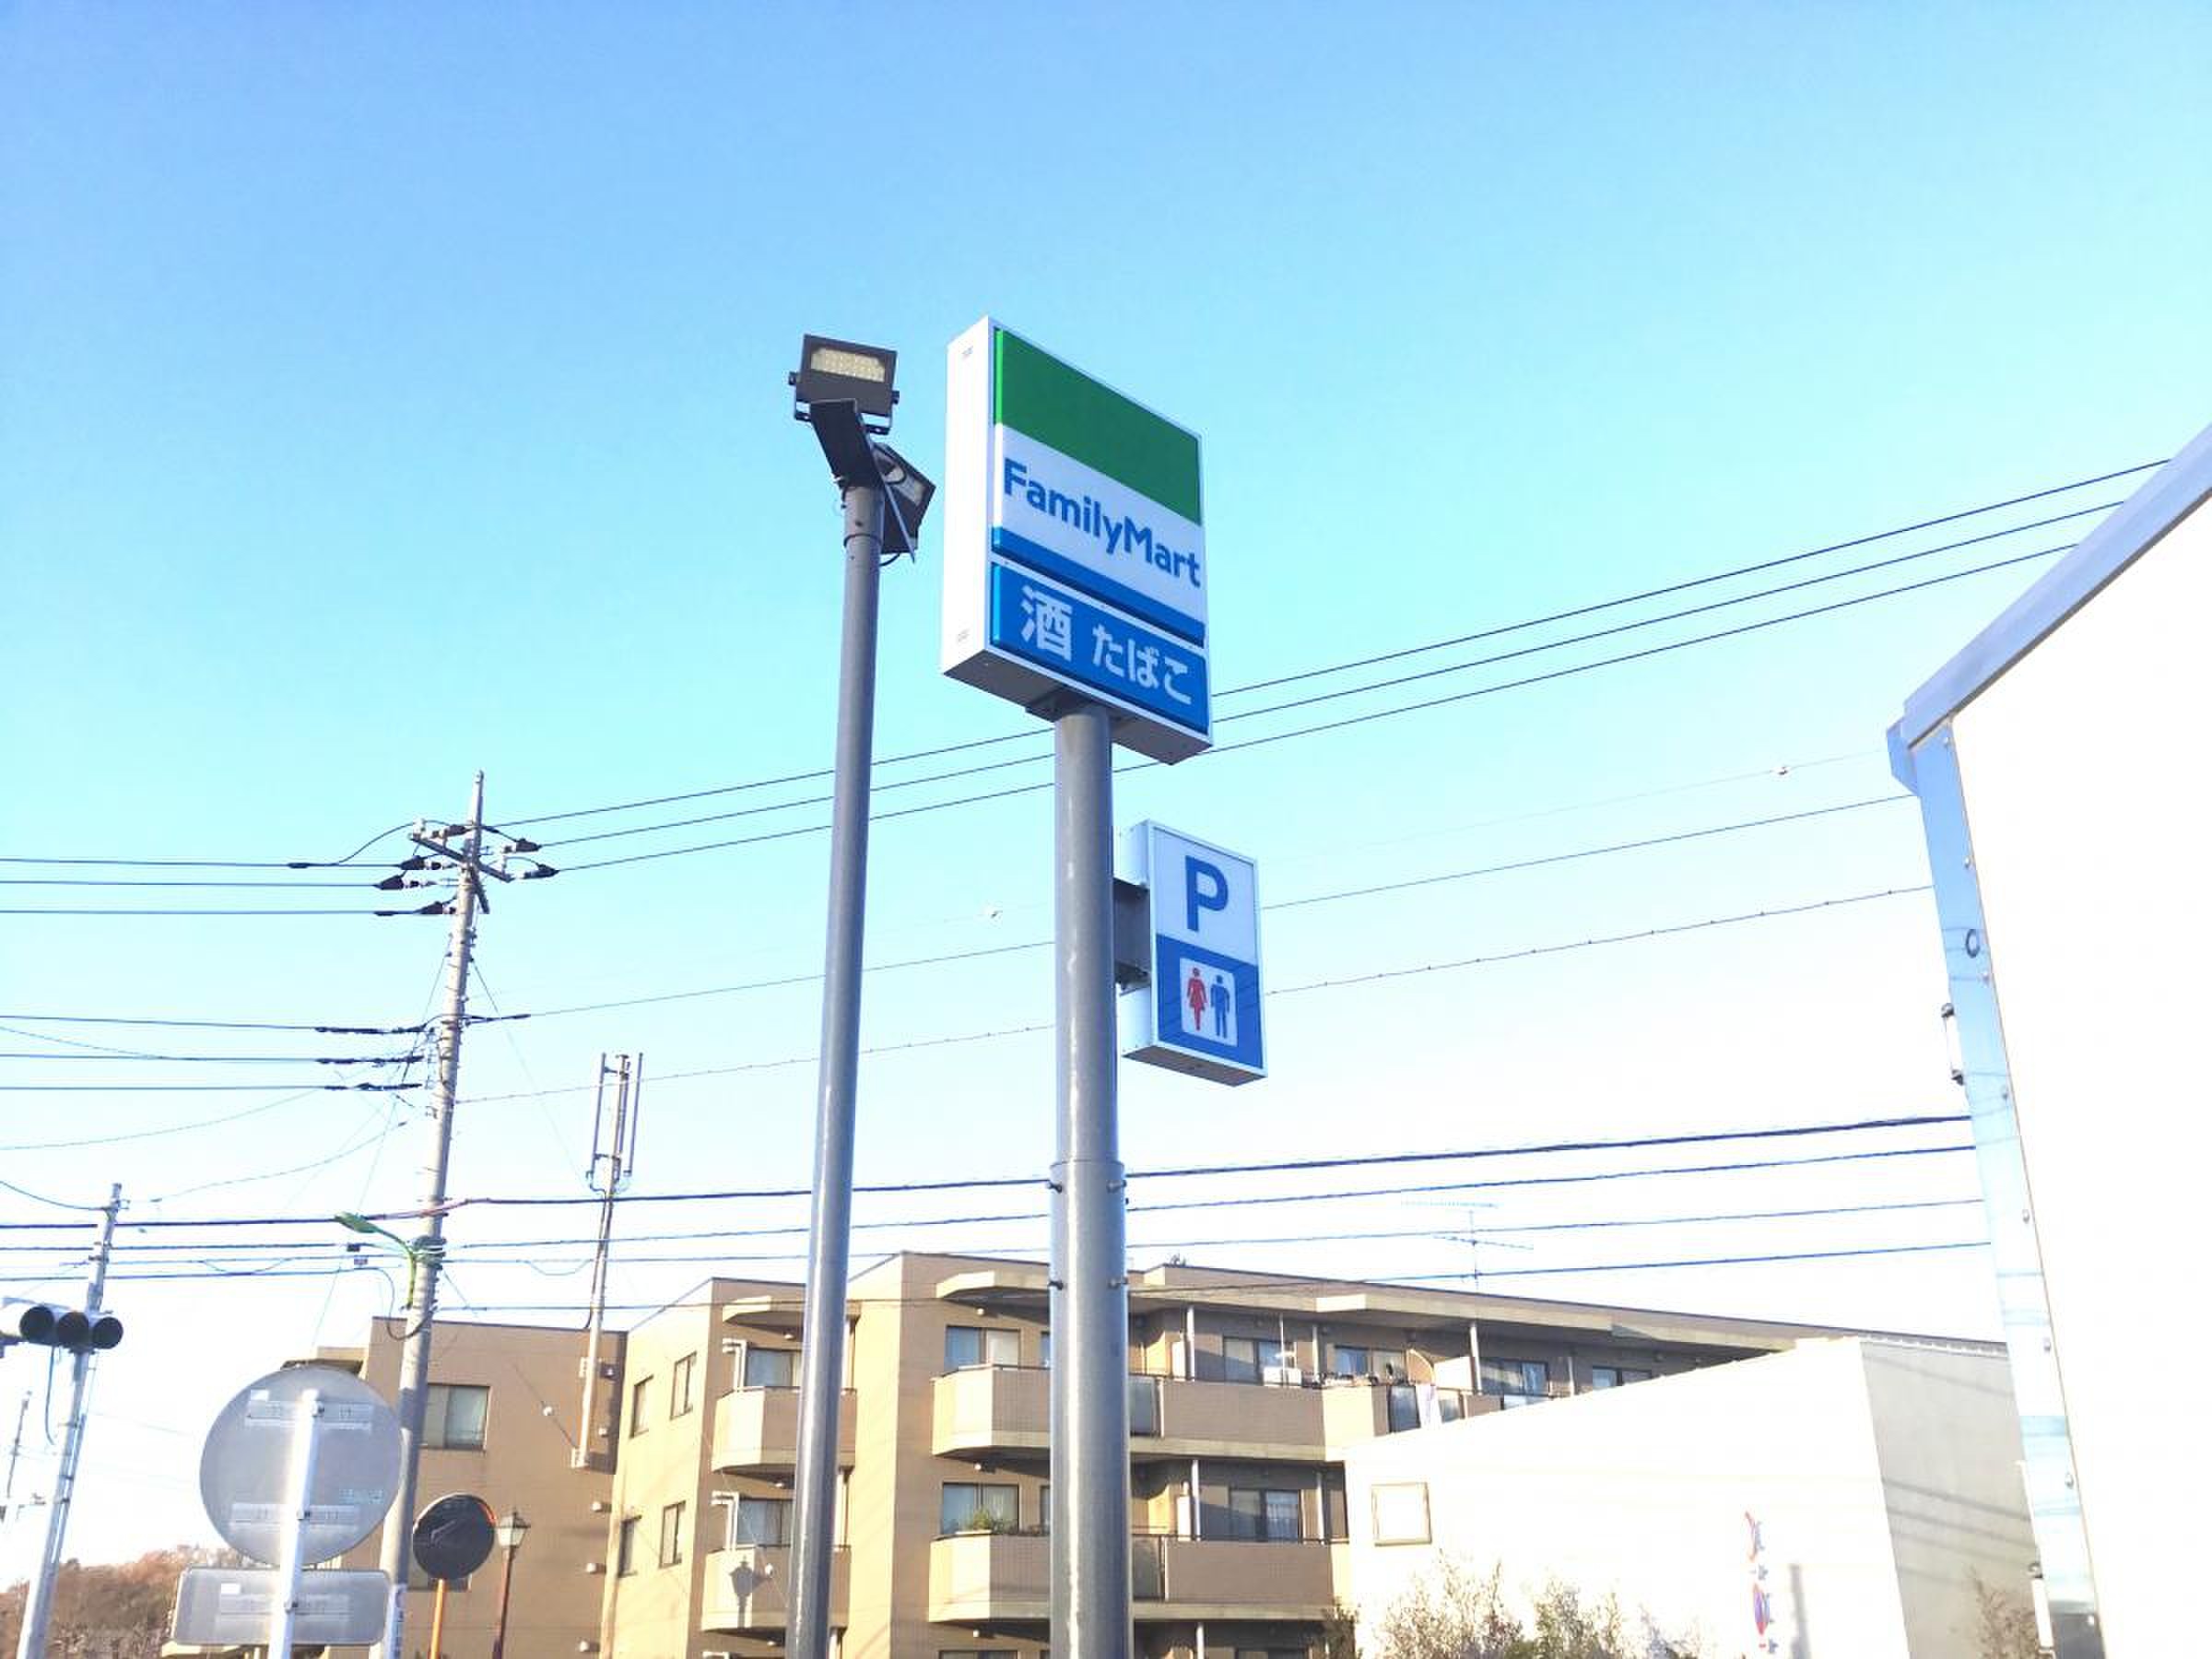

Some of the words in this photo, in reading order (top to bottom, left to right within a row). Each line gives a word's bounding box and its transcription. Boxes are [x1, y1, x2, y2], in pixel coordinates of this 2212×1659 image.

[1004, 457, 1200, 587] FamilyMart
[1020, 586, 1072, 661] 酒
[1092, 625, 1192, 704] たばこ
[1185, 855, 1229, 932] P
